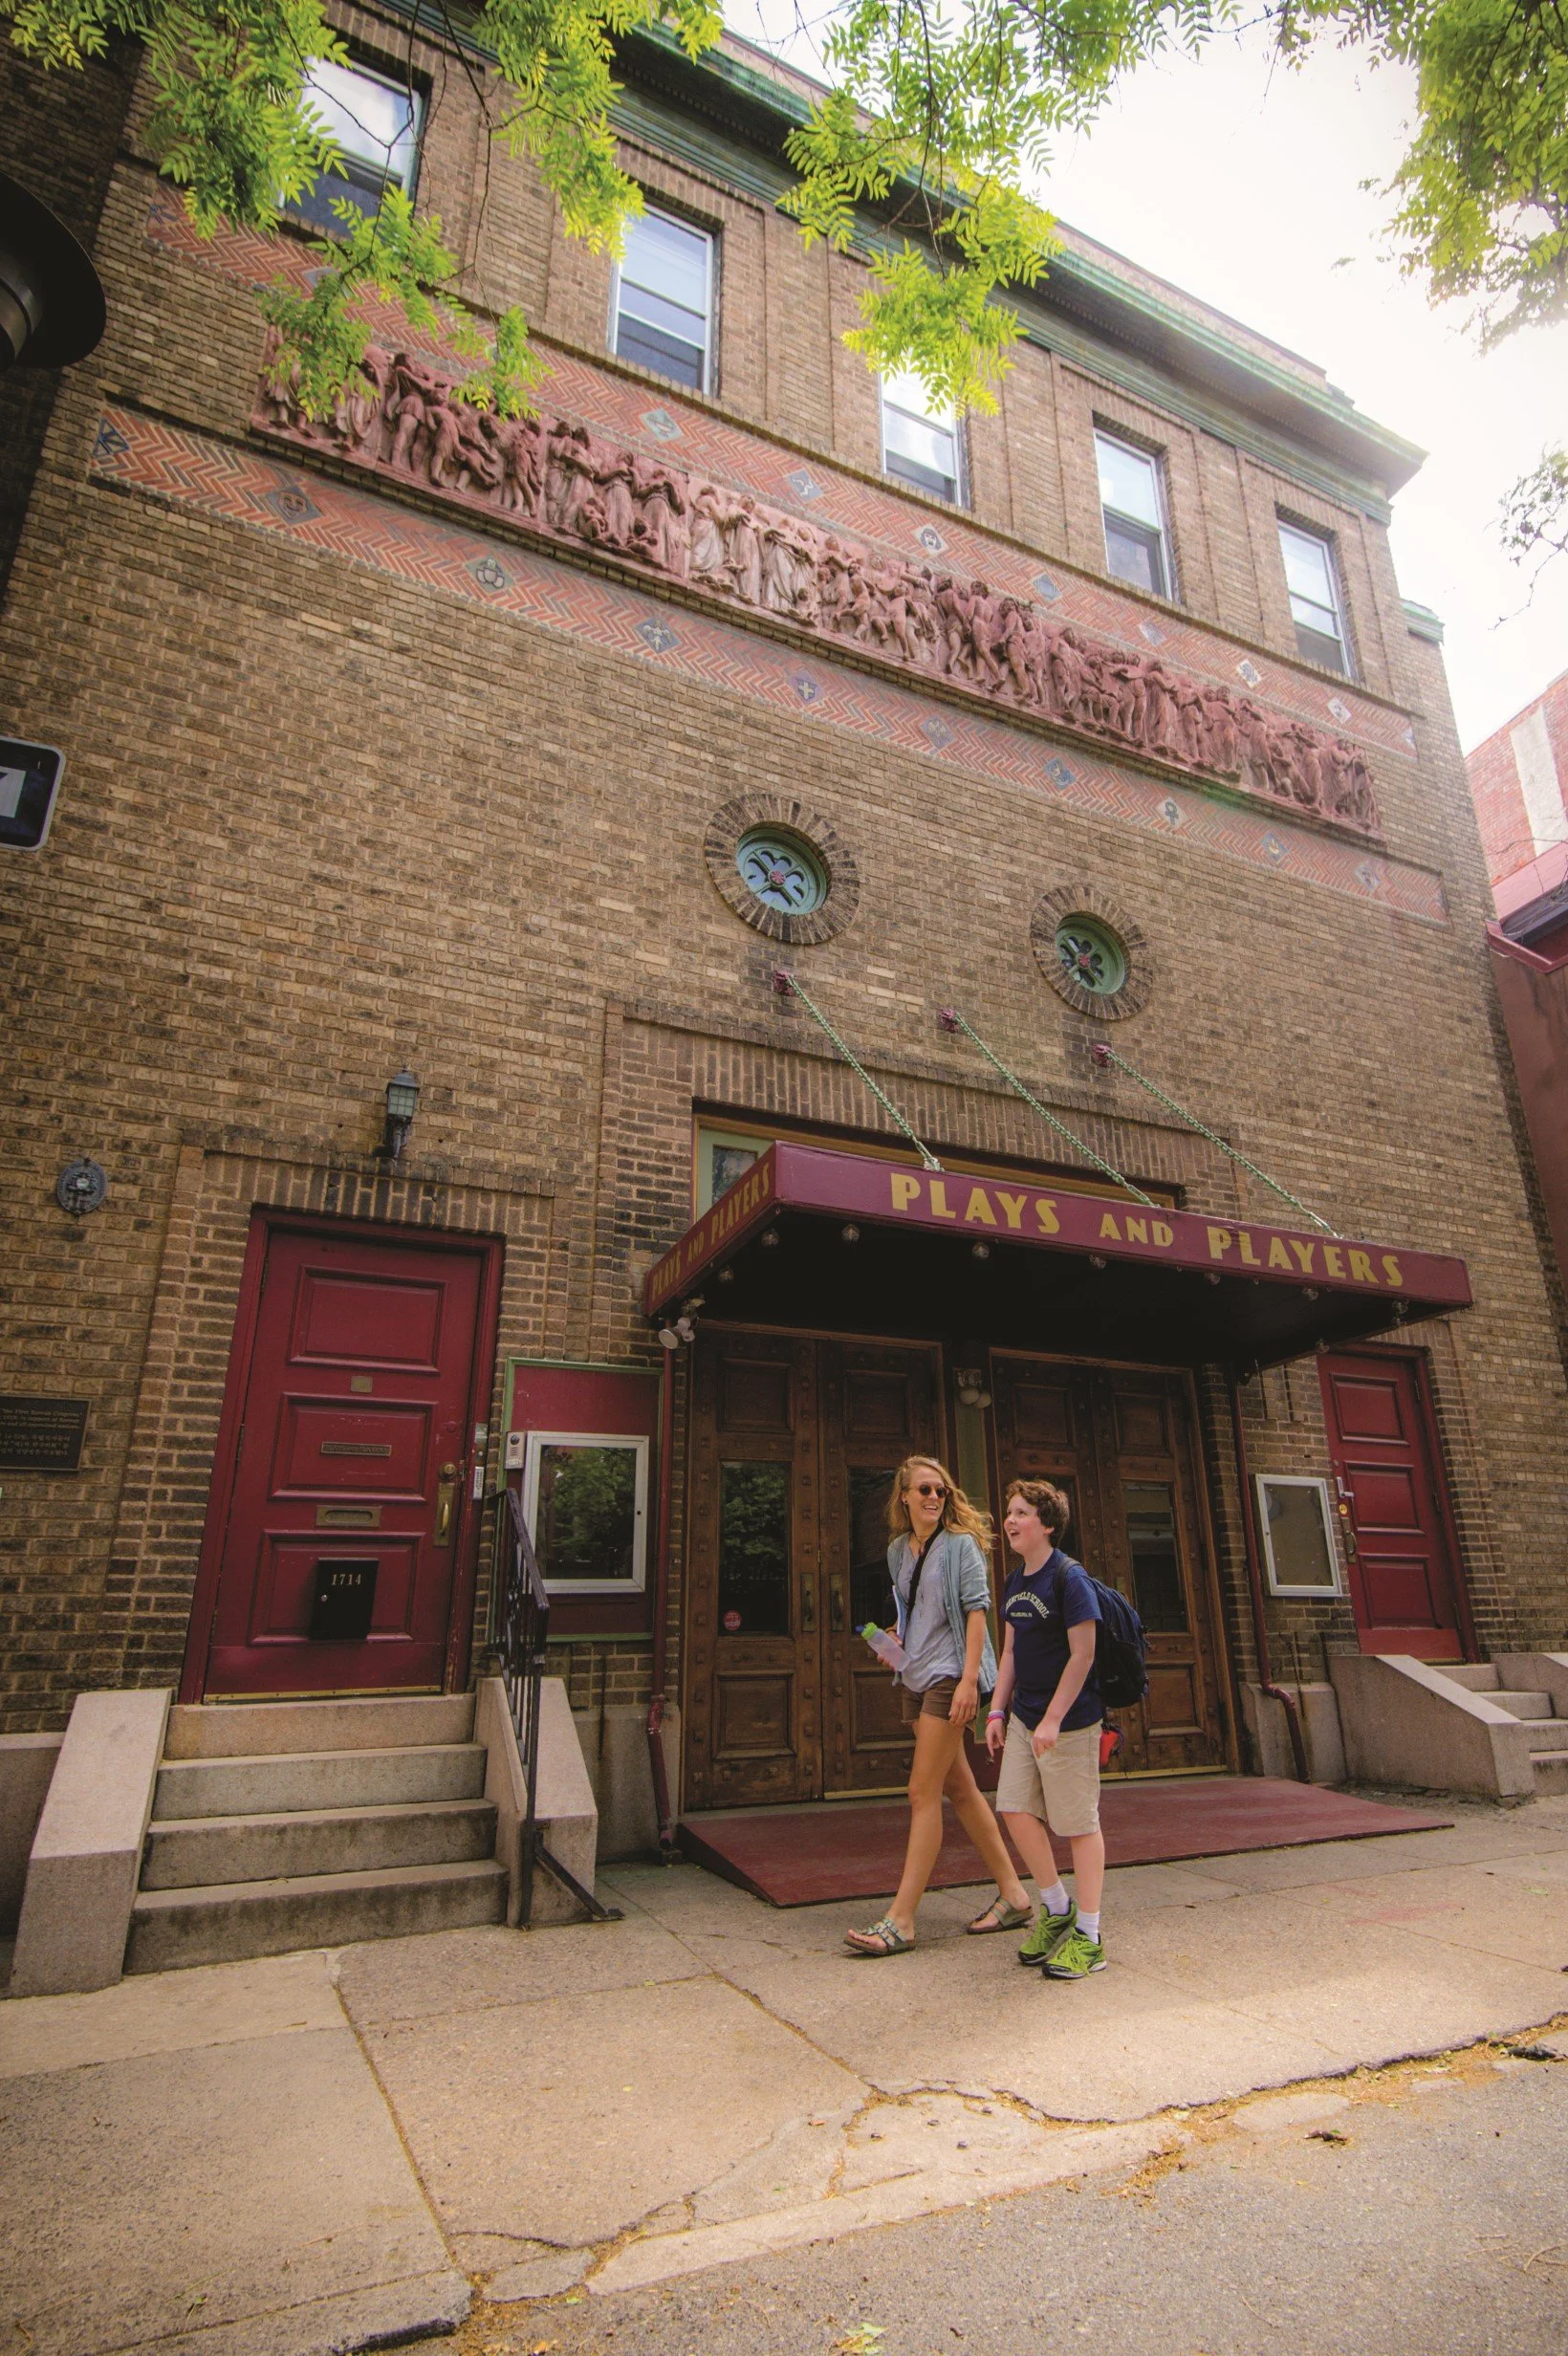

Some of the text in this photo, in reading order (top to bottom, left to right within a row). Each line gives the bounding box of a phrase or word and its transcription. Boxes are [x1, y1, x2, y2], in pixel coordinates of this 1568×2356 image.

[652, 1163, 770, 1301] PLAYS AND PLAYERS
[891, 1173, 1404, 1287] PLAYS AND PLAYERS
[331, 1573, 361, 1585] 1714
[1029, 1593, 1050, 1619] SCHOOL
